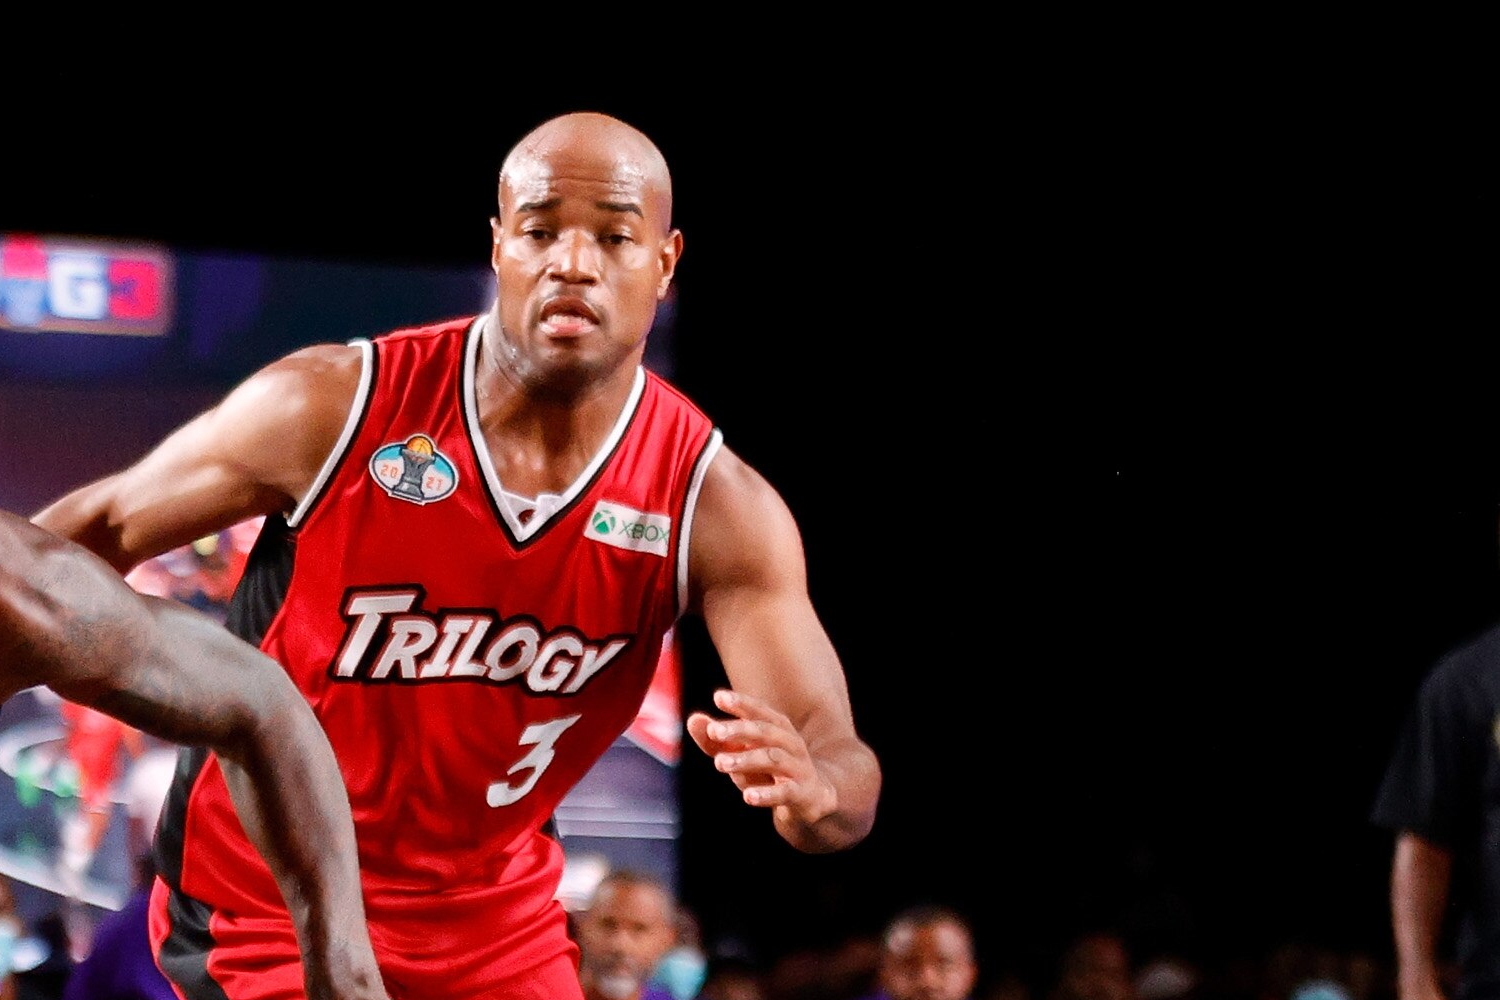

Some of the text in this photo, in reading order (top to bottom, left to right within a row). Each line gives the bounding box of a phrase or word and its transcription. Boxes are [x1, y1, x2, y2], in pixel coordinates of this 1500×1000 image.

[617, 519, 668, 545] XBOX
[334, 588, 632, 695] TRILOGY
[485, 713, 583, 808] 3
